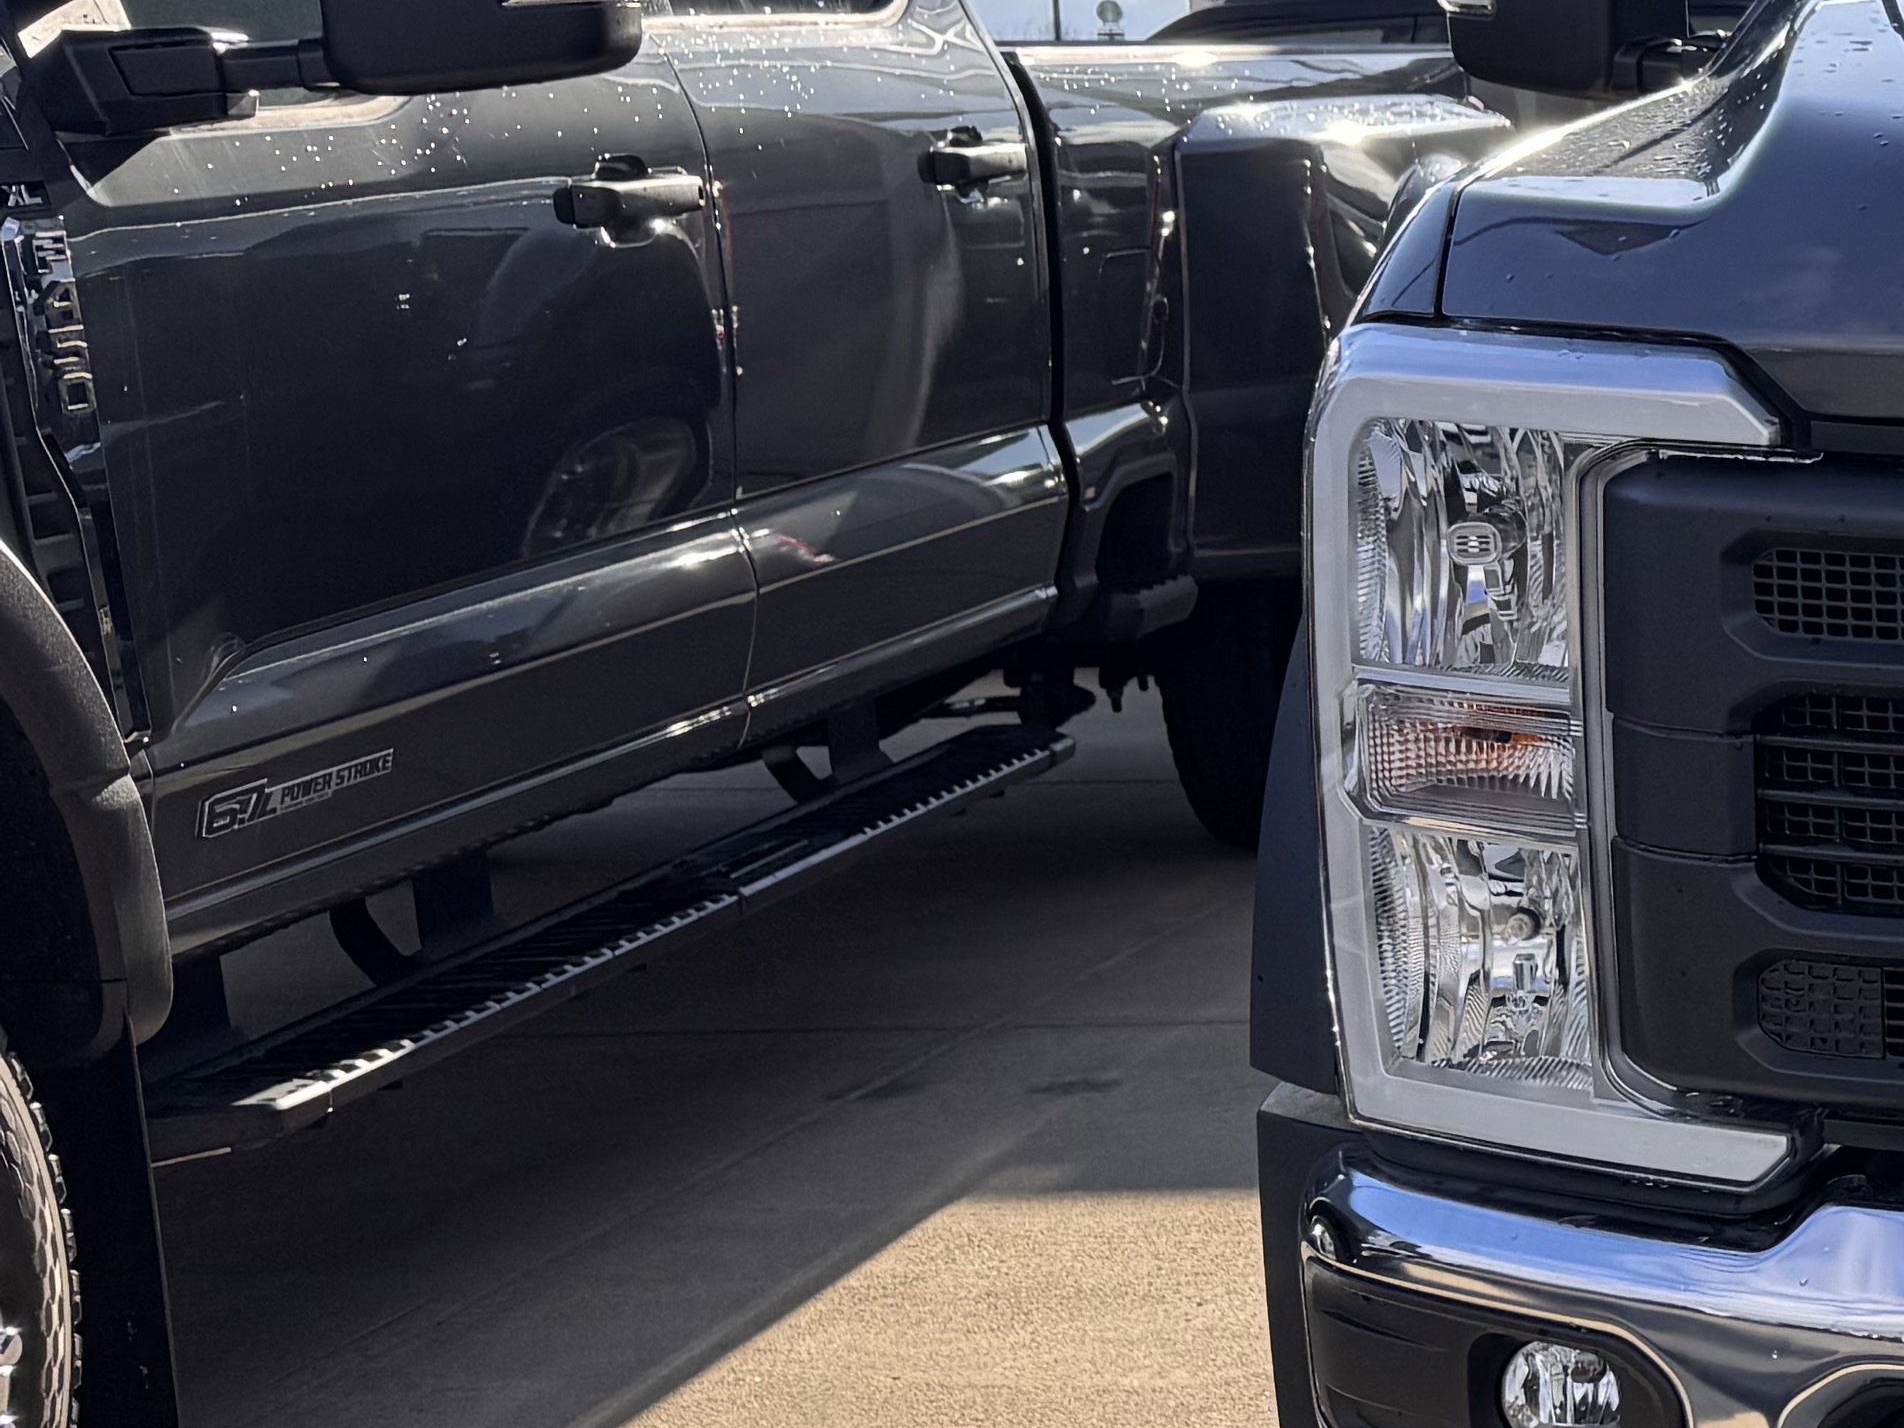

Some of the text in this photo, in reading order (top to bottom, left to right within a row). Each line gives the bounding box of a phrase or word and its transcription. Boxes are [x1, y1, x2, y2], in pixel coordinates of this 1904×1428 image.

[1, 184, 43, 207] XL
[280, 772, 332, 805] POWER
[334, 753, 393, 788] STROKE
